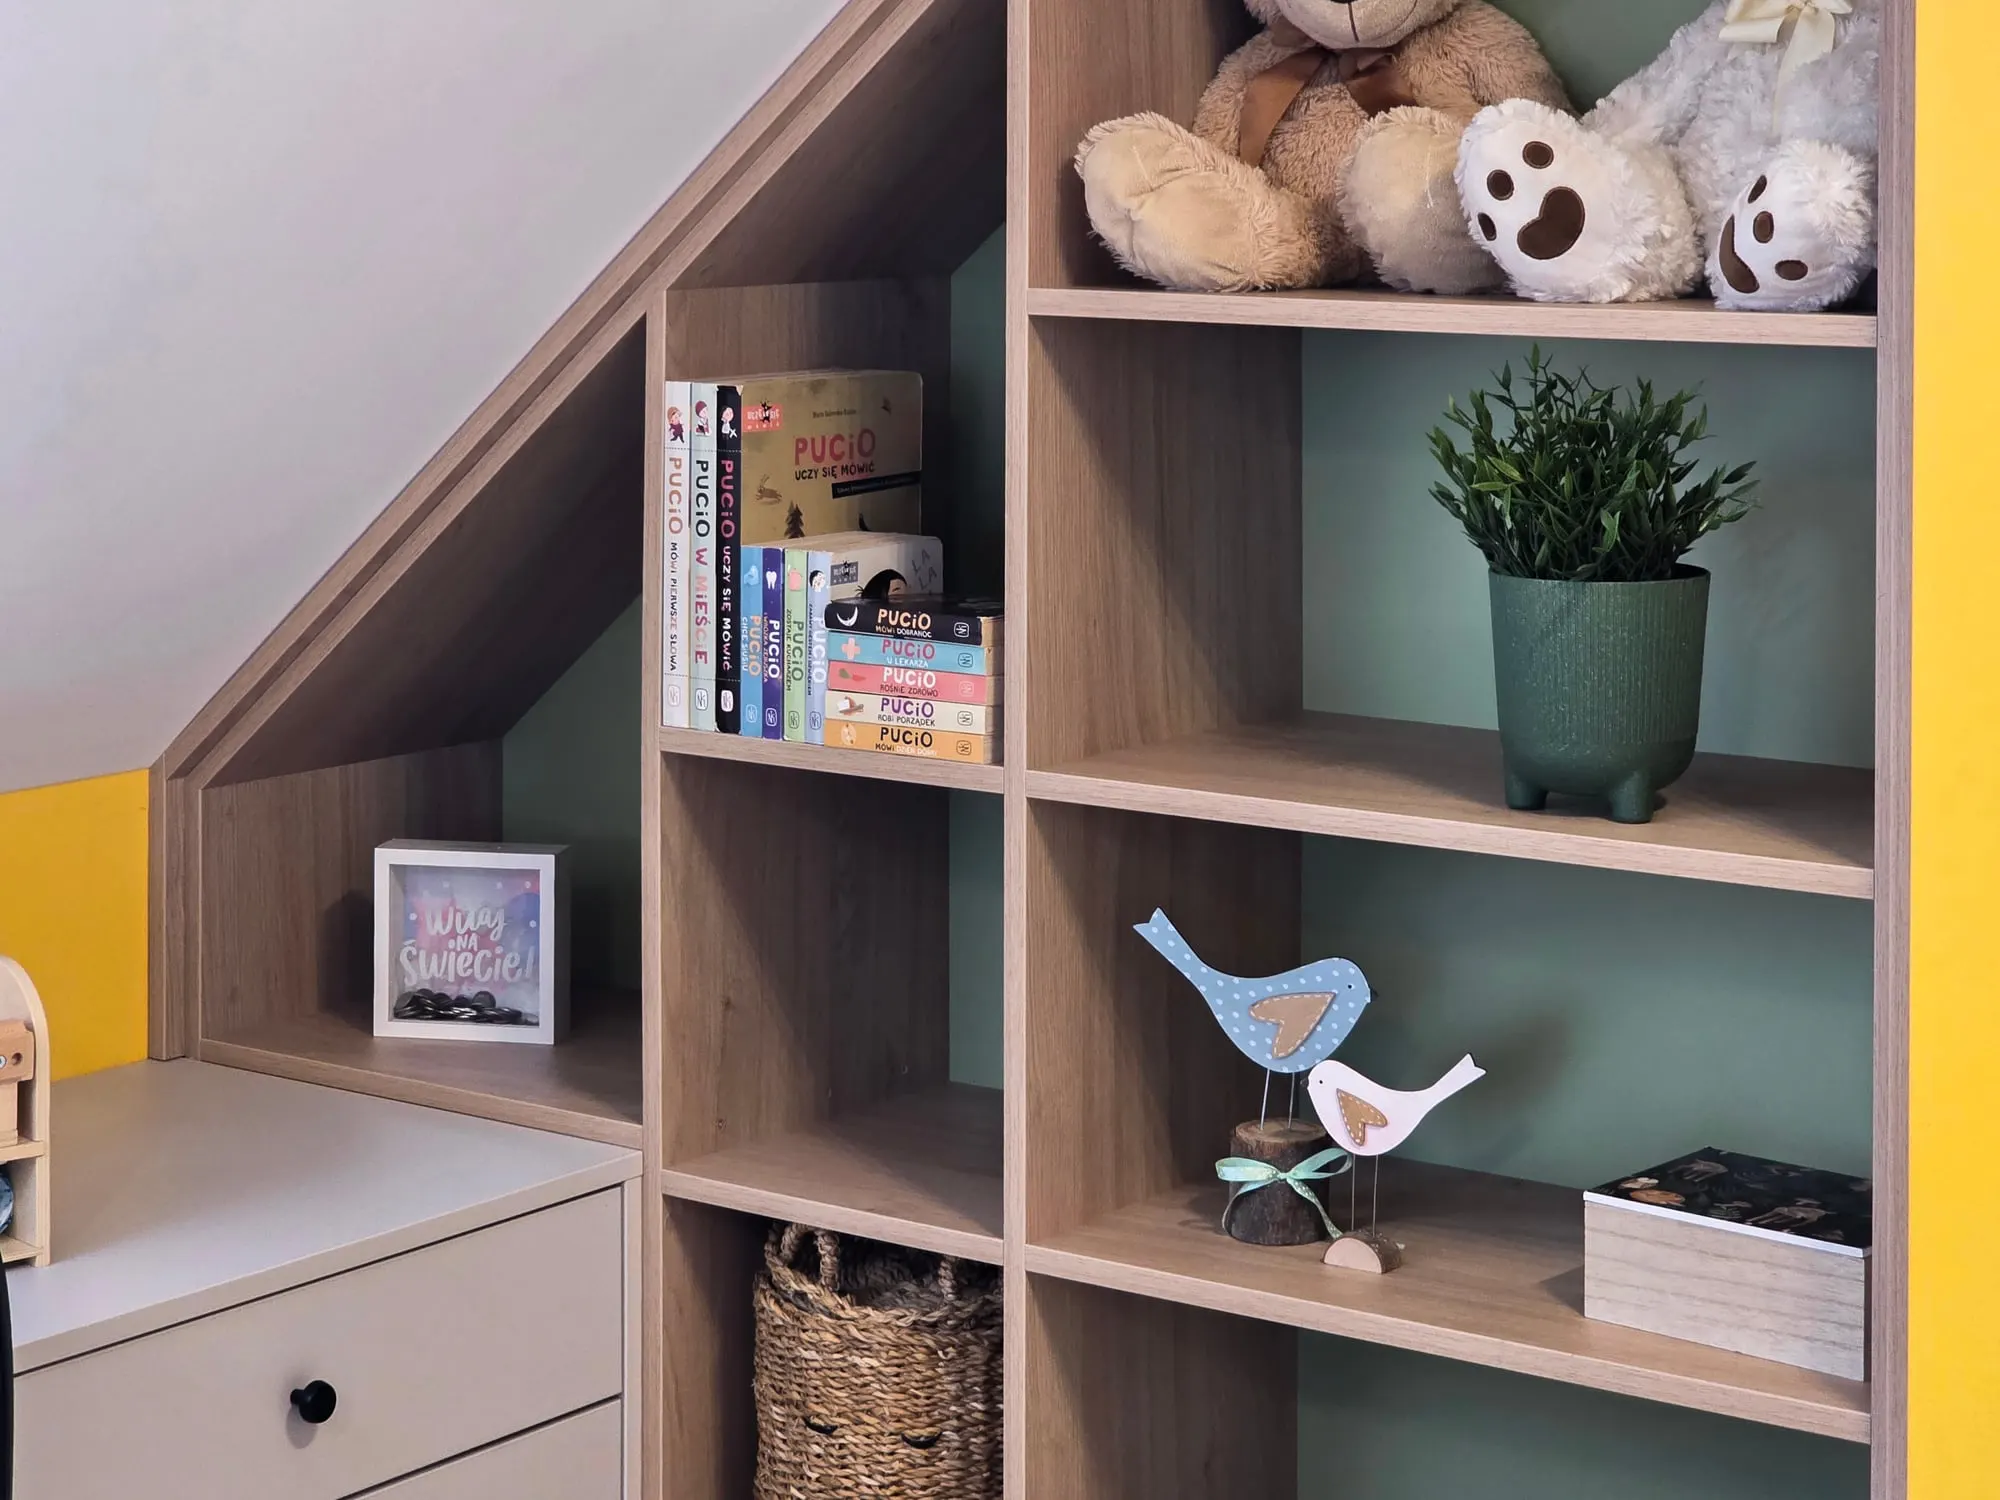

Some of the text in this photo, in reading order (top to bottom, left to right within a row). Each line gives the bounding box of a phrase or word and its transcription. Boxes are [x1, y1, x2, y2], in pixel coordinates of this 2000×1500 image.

[795, 469, 819, 480] UCZY
[695, 547, 708, 566] W
[722, 546, 731, 583] UCZY
[897, 628, 932, 638] DOBRANOC
[670, 634, 678, 671] SŁOWA
[887, 656, 928, 668] U LEKARZA
[908, 688, 938, 697] ZDROWO
[457, 933, 479, 951] NA
